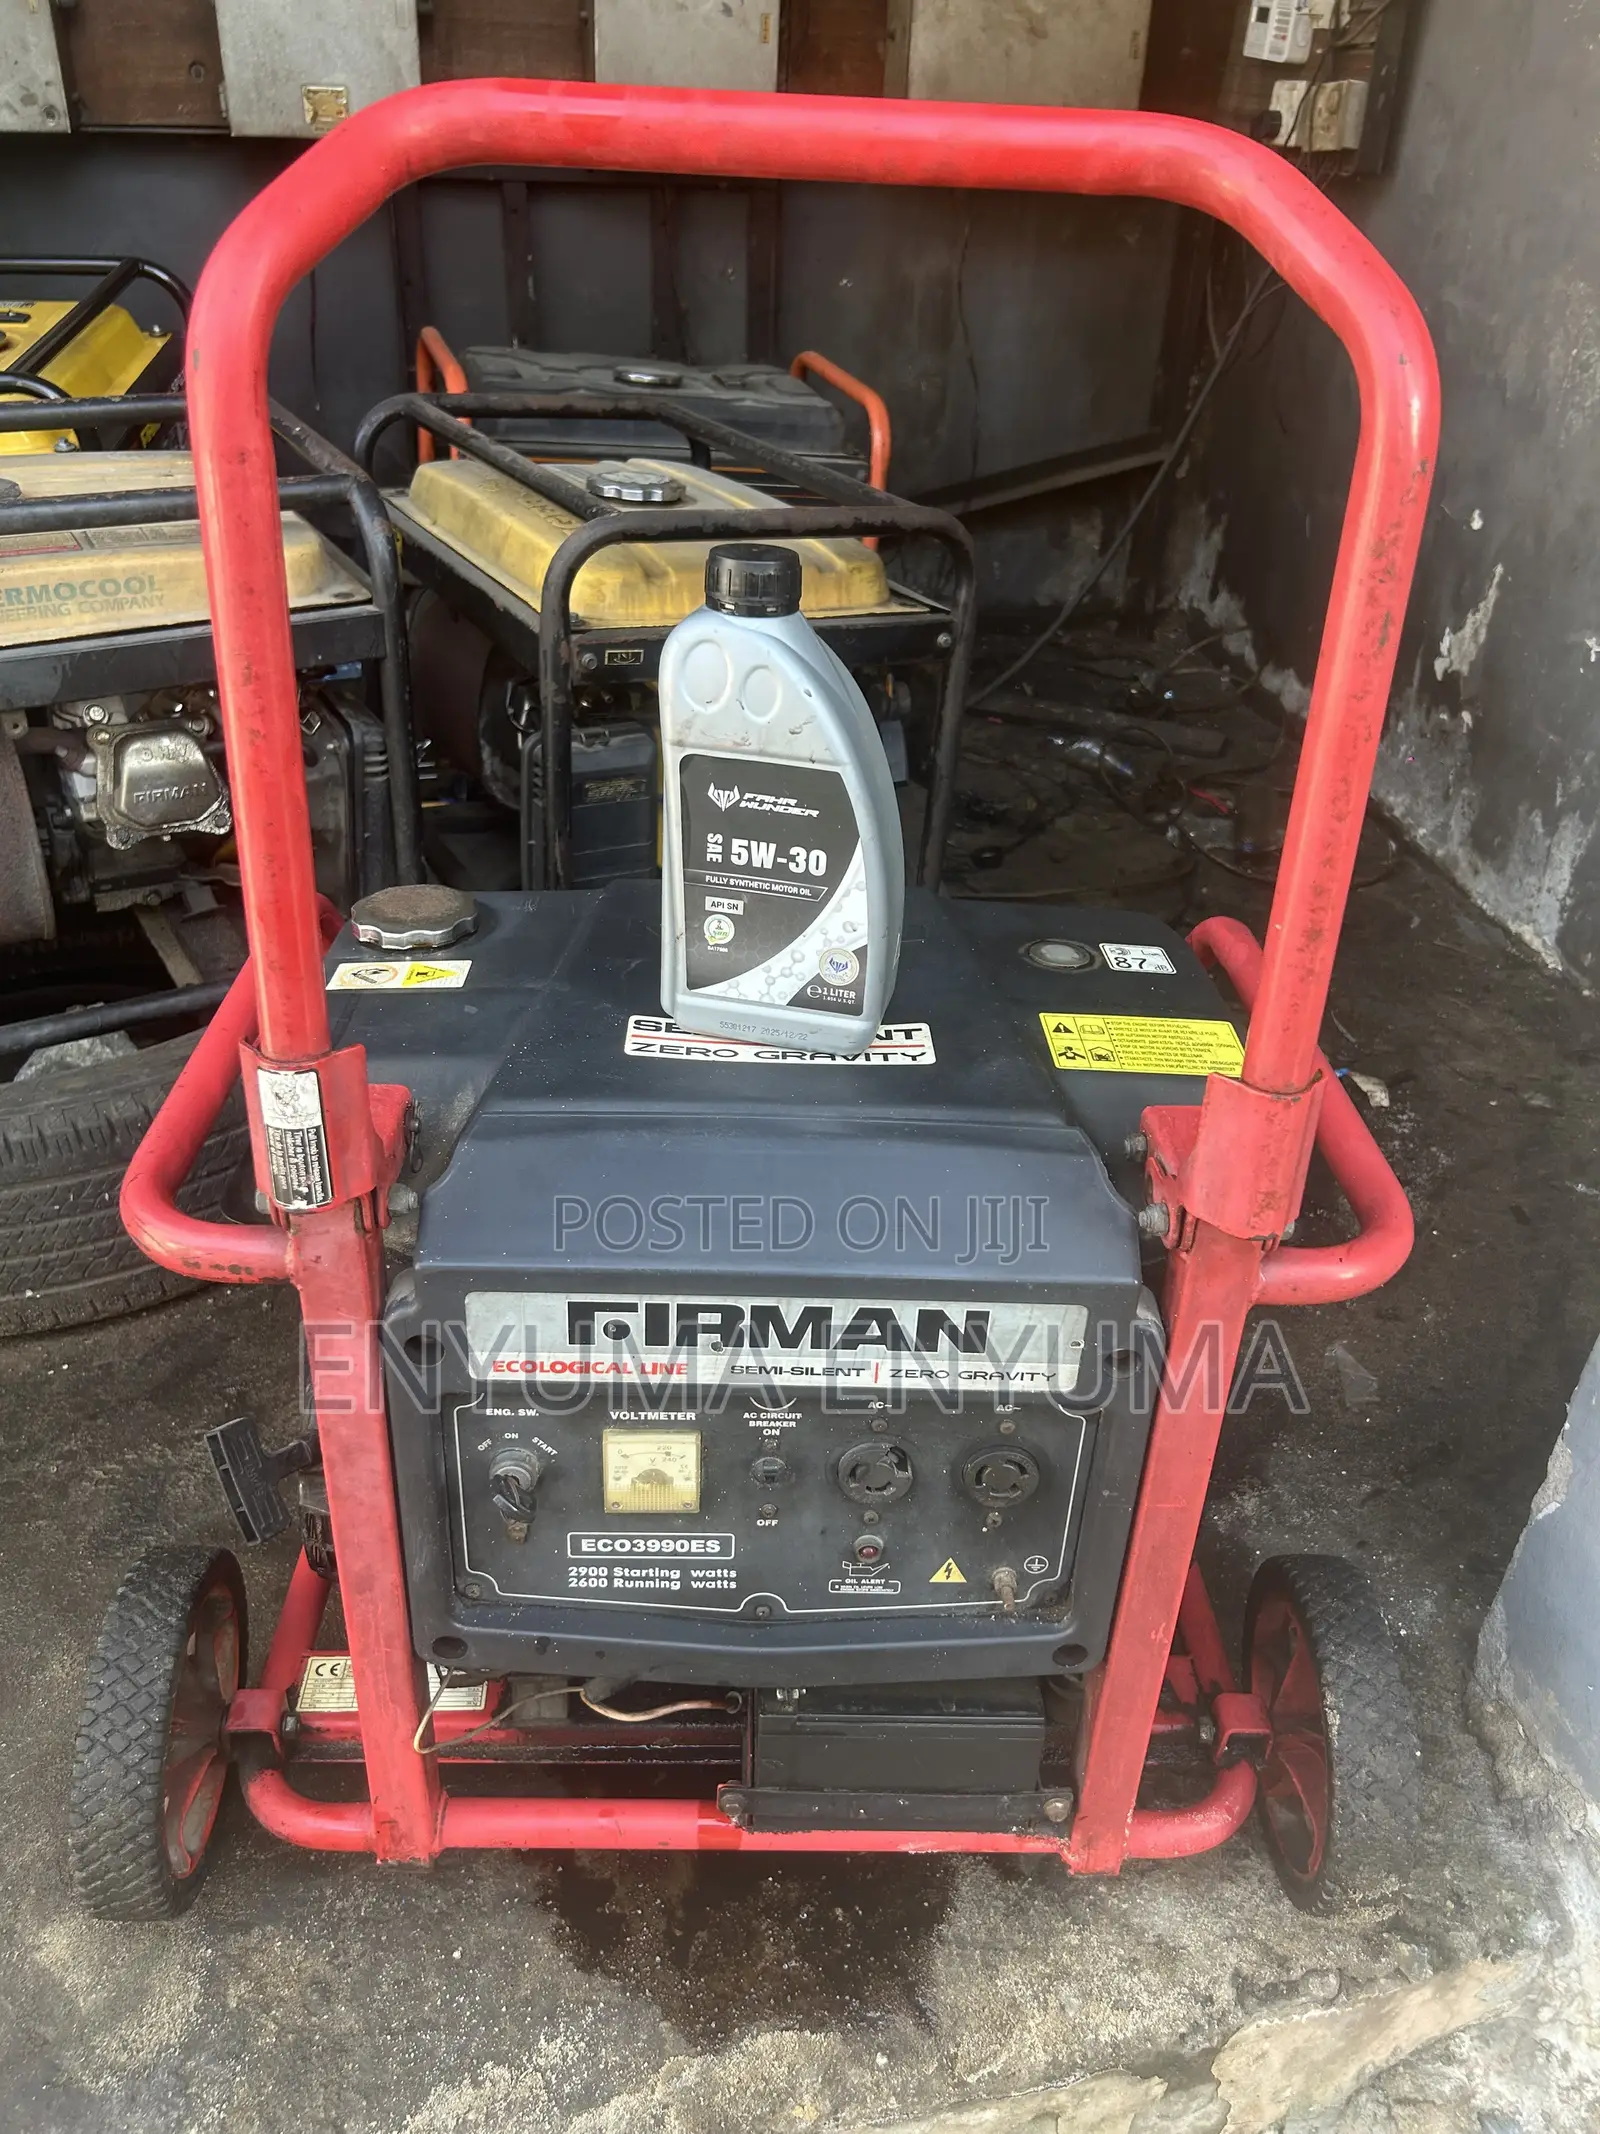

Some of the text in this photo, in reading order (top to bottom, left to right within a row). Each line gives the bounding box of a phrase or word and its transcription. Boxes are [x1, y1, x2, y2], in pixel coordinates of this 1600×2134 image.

[77, 594, 165, 614] COMPANY
[743, 792, 798, 806] FAHR
[739, 800, 820, 818] WUNDER
[706, 833, 827, 877] SAE 5W-30
[705, 875, 812, 896] FULLY SYNTHETIC MOTOR OIL
[710, 900, 739, 911] API SN
[1114, 956, 1147, 969] 87
[822, 987, 828, 995] 1
[829, 988, 856, 999] LITER
[630, 1042, 927, 1062] ZERO GRAVITY
[566, 1300, 991, 1354] FIRMAN
[492, 1360, 688, 1376] ECOLOGICAL LINE
[730, 1365, 1057, 1382] SEMI-SILENT ZERO GRAVITY
[485, 1408, 540, 1417] ENG. SW.
[609, 1411, 697, 1421] VOLTMETER
[760, 1412, 802, 1420] CIRCUIT
[748, 1420, 797, 1428] BREAKER
[762, 1428, 780, 1436] ON
[477, 1438, 493, 1452] OFF
[531, 1436, 558, 1457] START
[756, 1519, 779, 1527] OFF
[581, 1538, 721, 1553] ECO3990ES
[568, 1566, 737, 1579] 2900 Starting watts
[568, 1577, 737, 1590] 2600 Running watts
